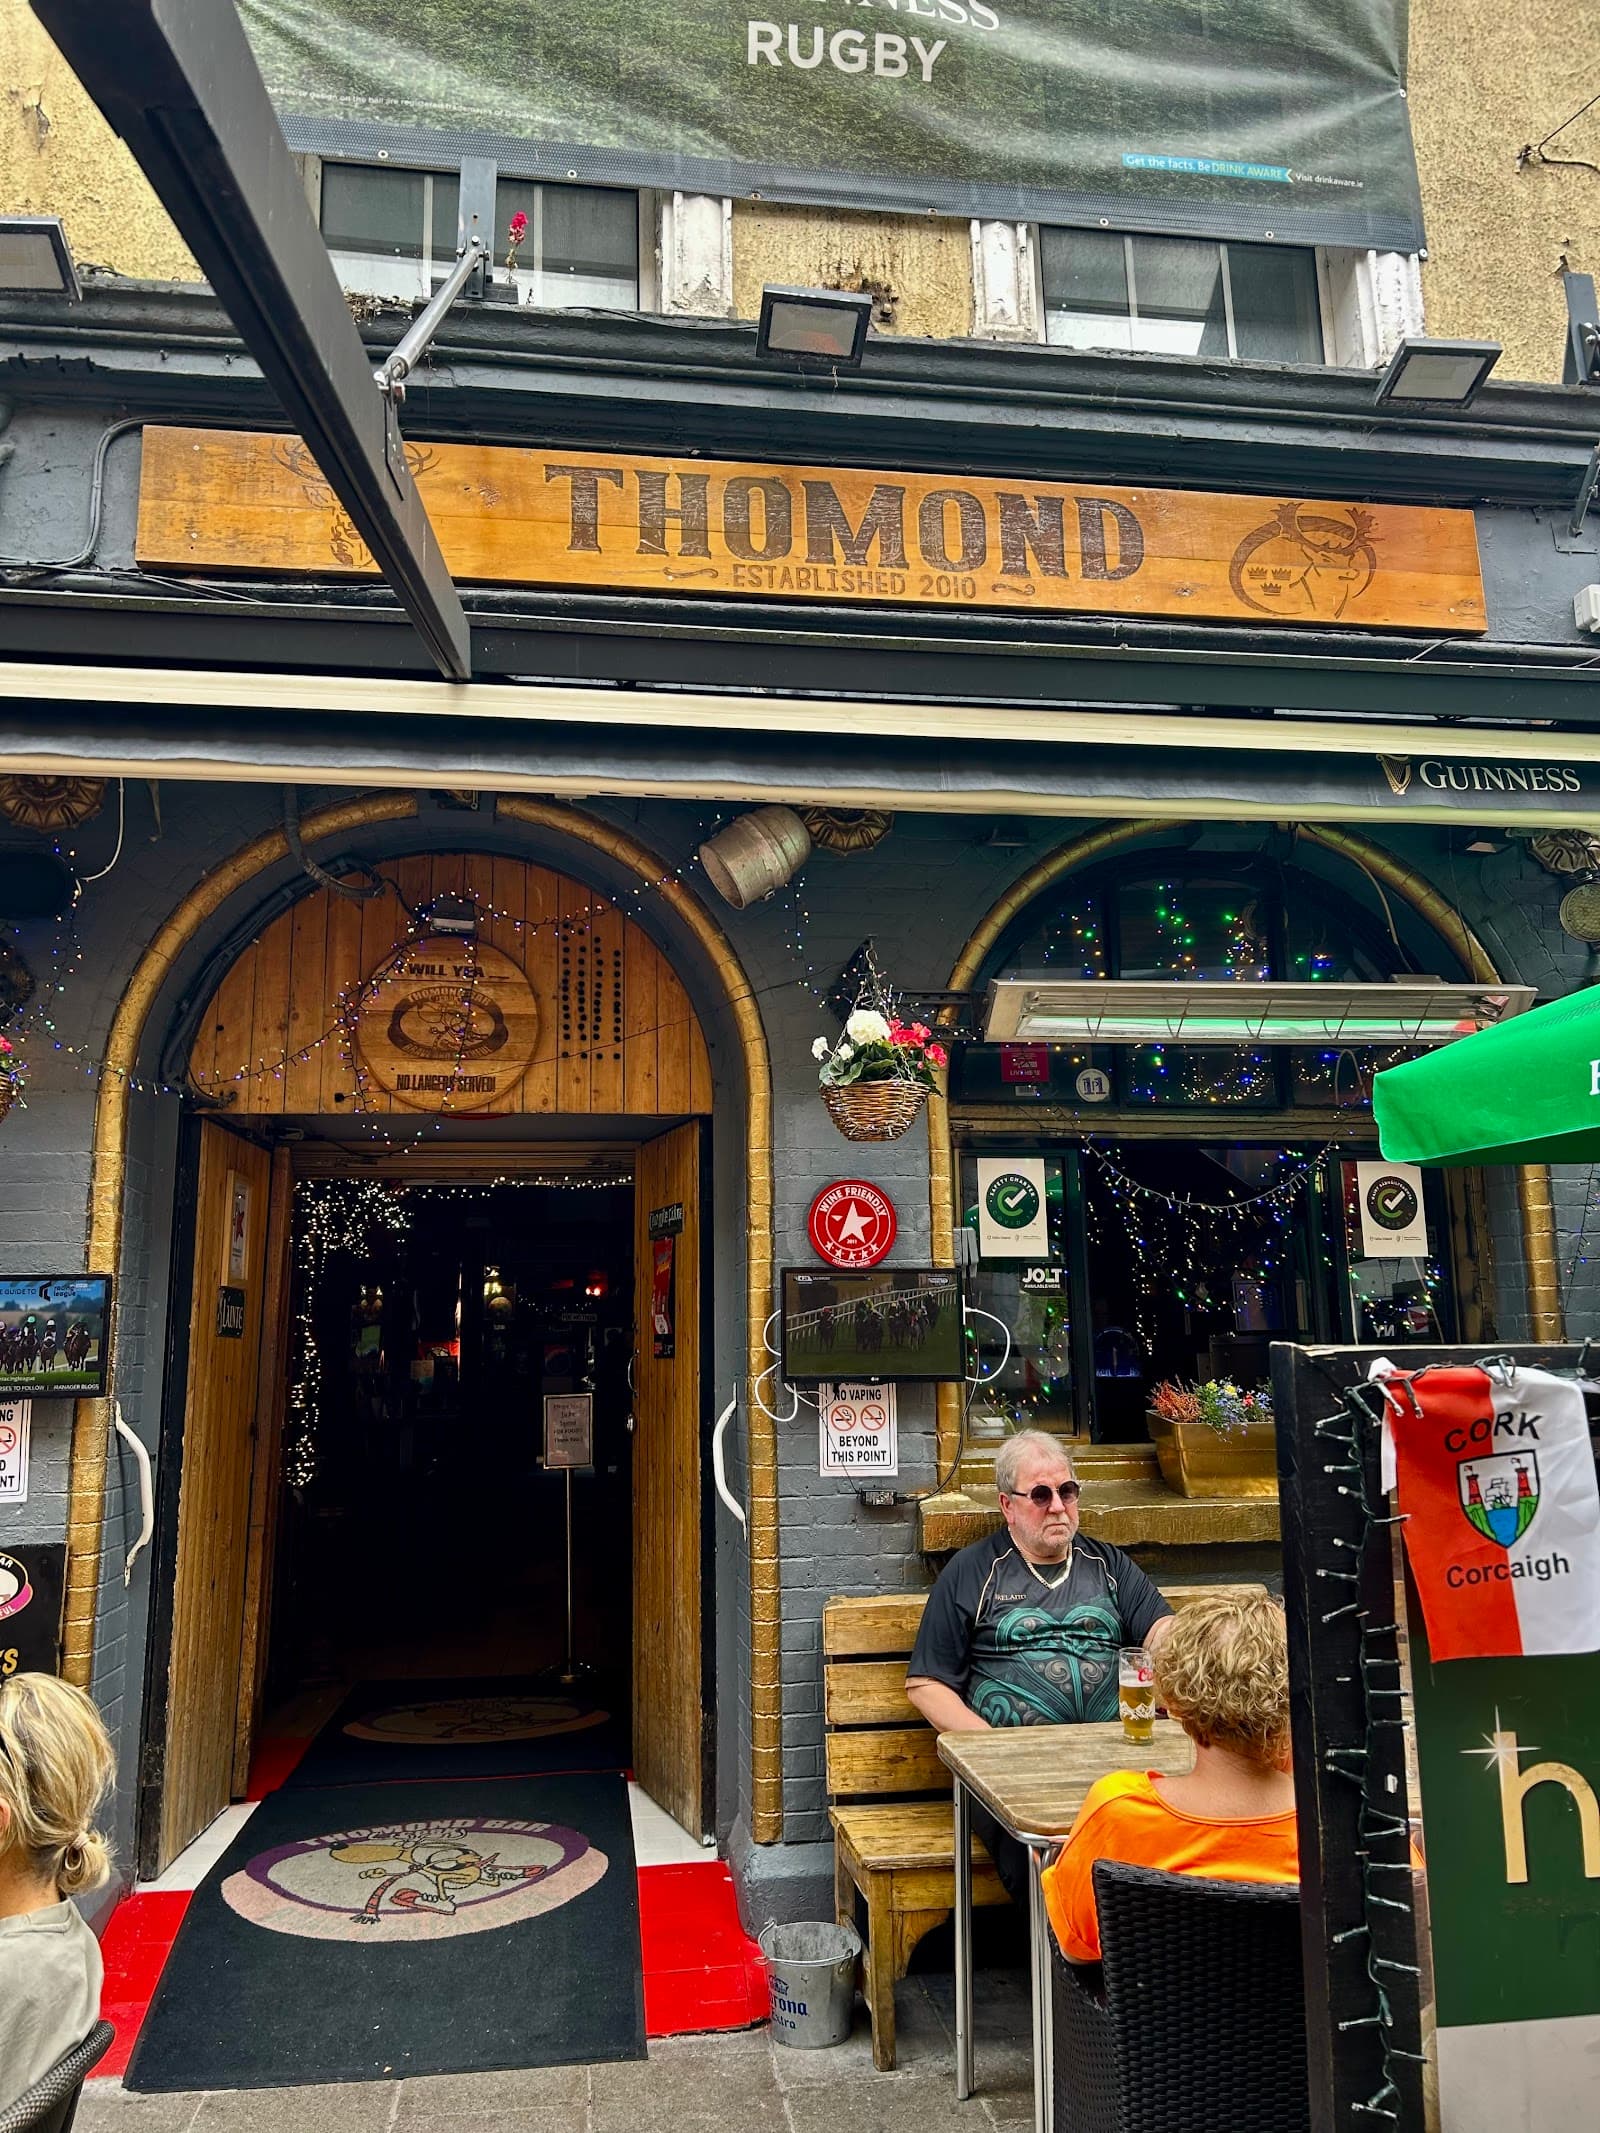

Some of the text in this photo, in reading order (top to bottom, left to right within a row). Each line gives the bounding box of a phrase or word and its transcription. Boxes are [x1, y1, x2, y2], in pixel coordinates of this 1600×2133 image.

[747, 20, 948, 82] RUGBY
[1126, 156, 1364, 188] Get the facts. Be DRINK AWARE Visit drinkaware.ie
[544, 463, 1146, 581] THOMOND
[732, 563, 977, 599] ESTABLISHED 2010
[1419, 760, 1582, 792] GUINNESS
[408, 963, 448, 976] WILL
[397, 1074, 410, 1090] NO
[989, 1176, 1036, 1197] SAFETY CHARTER
[818, 1187, 888, 1216] WINE FRIENDLY
[1022, 1268, 1062, 1283] JOLT
[53, 1289, 76, 1298] league
[834, 1389, 882, 1401] NO VAPING
[839, 1435, 879, 1447] BEYOND
[1443, 1411, 1543, 1453] CORK
[831, 1450, 887, 1463] THIS POINT
[1446, 1551, 1570, 1589] Corcaigh
[0, 1647, 19, 1675] S
[296, 1818, 553, 1847] THOMOND BAR
[771, 1995, 808, 2016] rona
